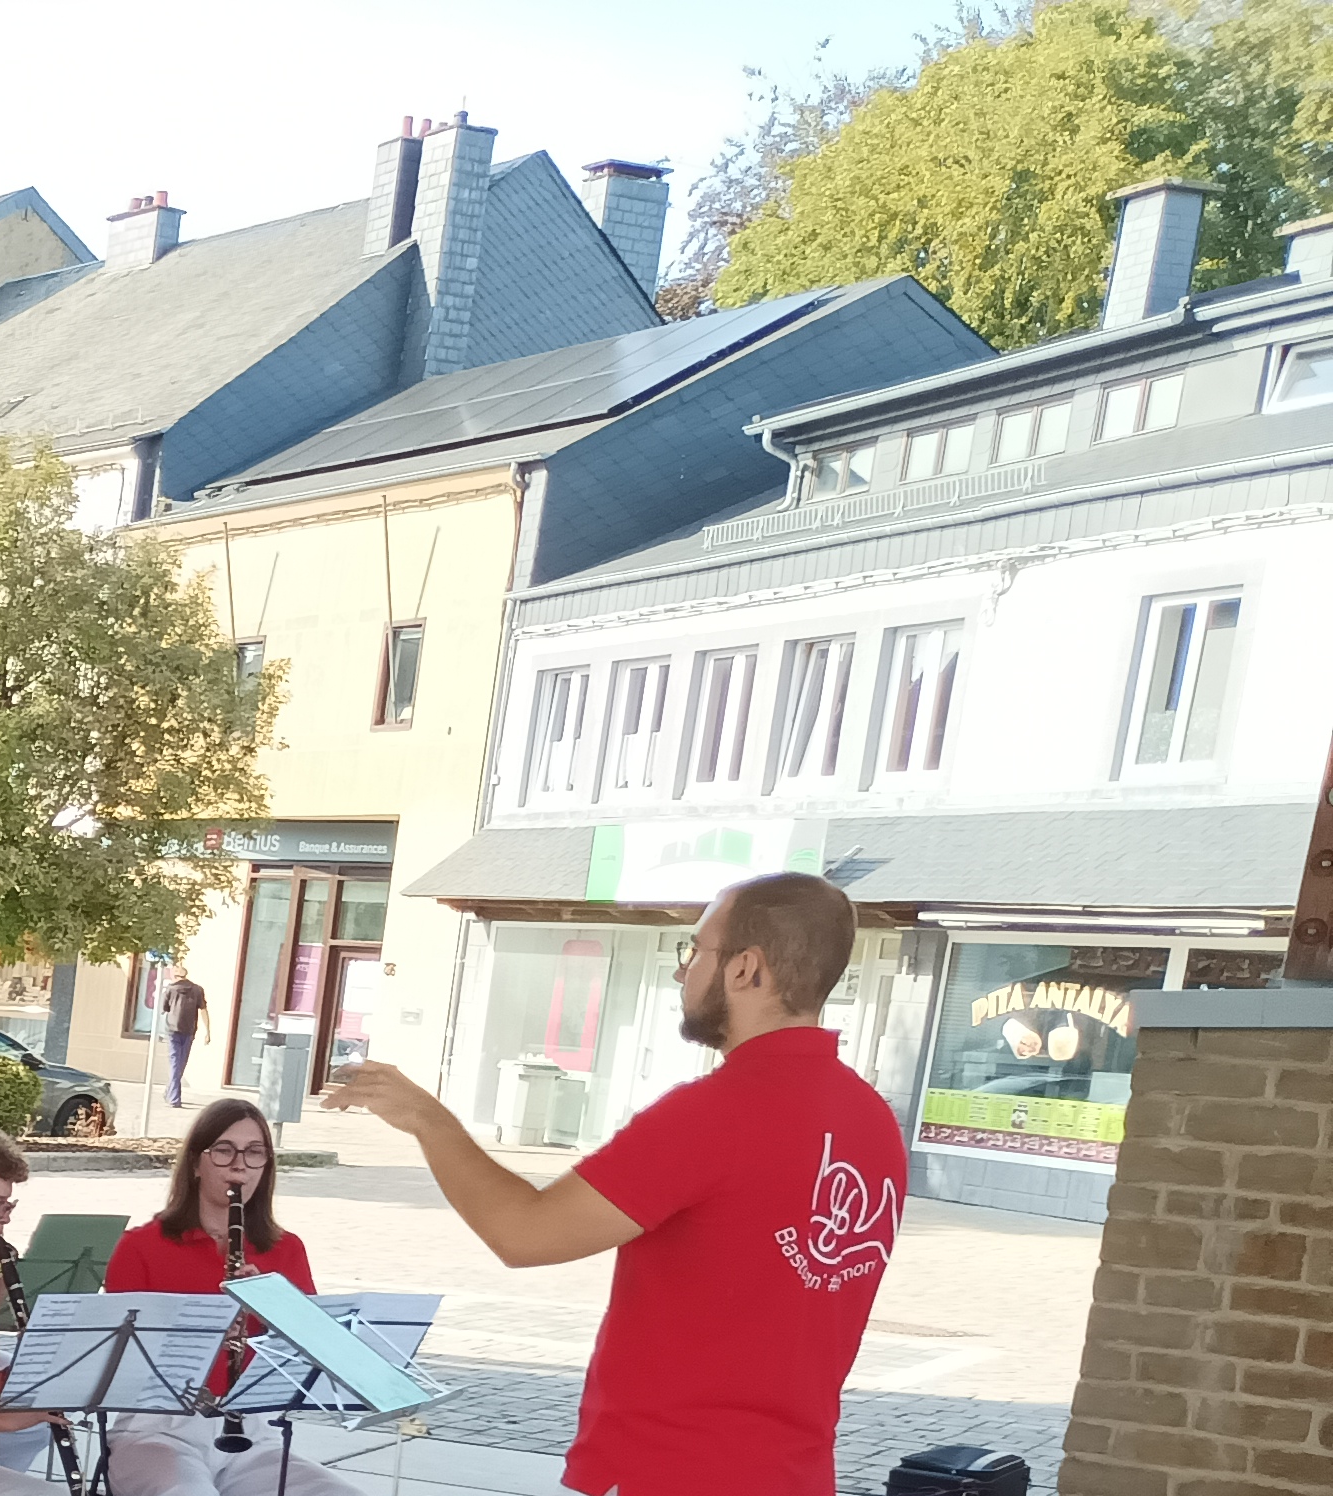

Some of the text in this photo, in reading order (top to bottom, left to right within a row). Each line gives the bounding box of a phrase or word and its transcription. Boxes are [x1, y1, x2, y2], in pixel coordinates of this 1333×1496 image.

[298, 841, 330, 854] Banque
[331, 842, 338, 853] &
[338, 843, 387, 855] Assurances
[971, 981, 1131, 1039] PITA ANTALYA
